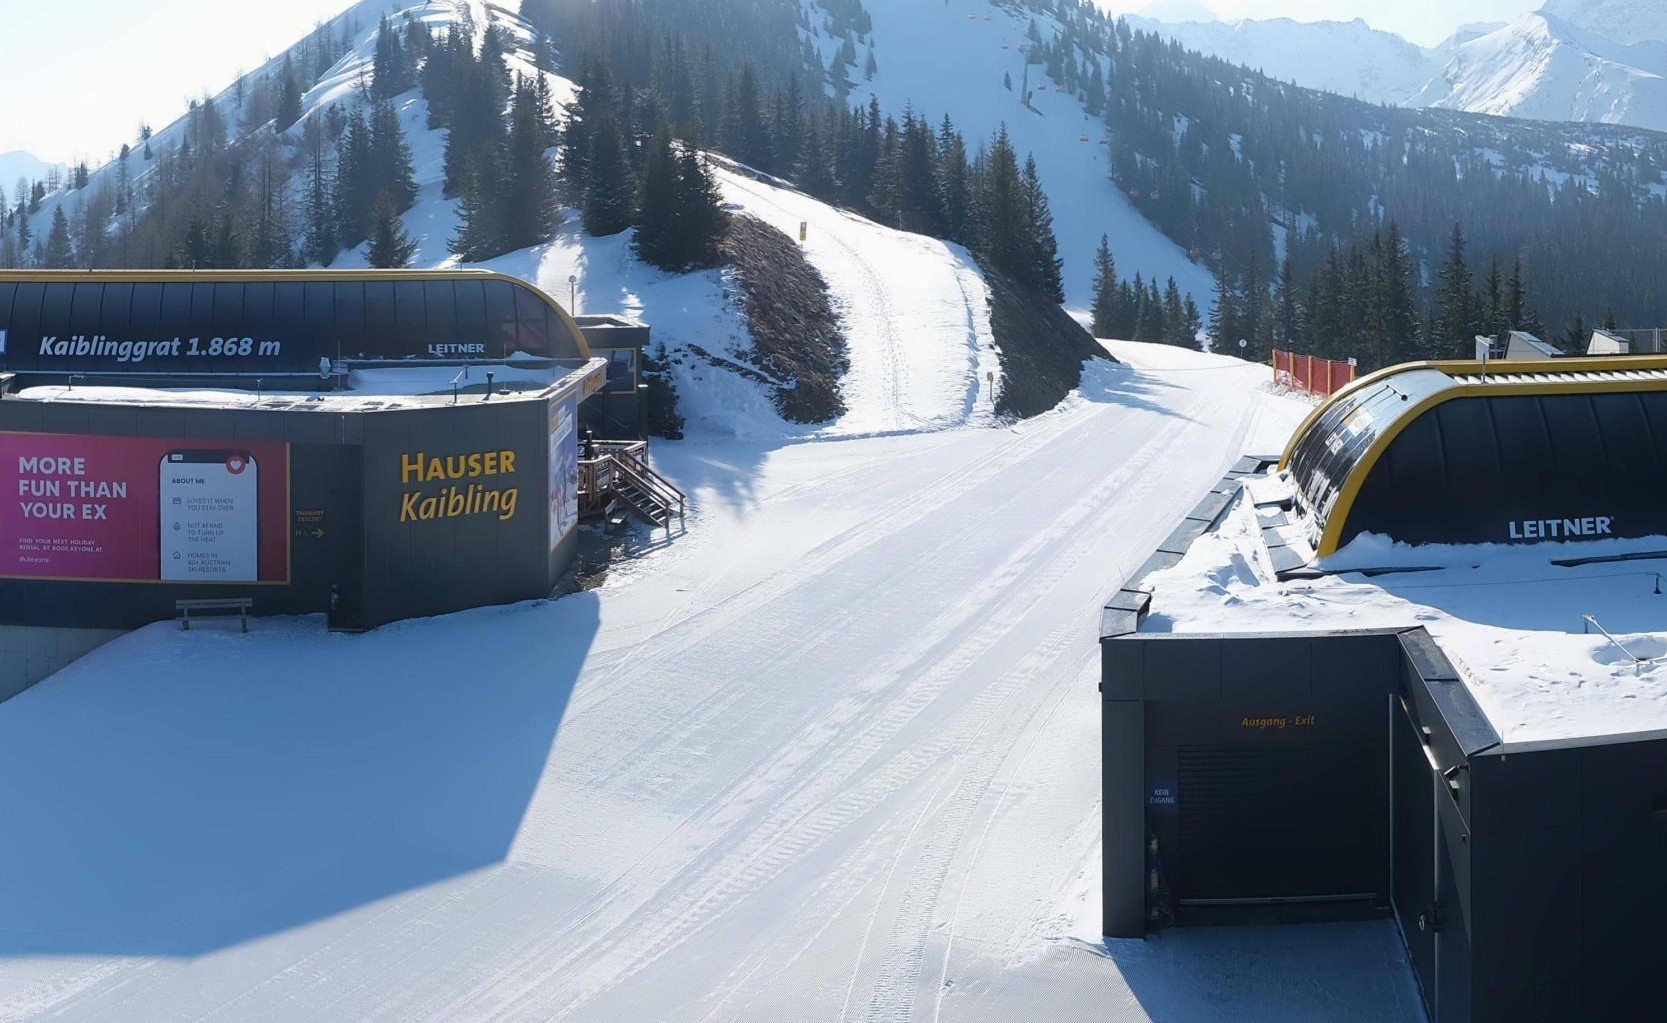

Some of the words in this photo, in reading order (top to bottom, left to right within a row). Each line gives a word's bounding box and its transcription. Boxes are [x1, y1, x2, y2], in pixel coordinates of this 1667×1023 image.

[39, 335, 180, 362] Kaiblinggrat
[186, 337, 253, 356] 1.868
[258, 340, 281, 356] m
[428, 343, 485, 354] LEITNER
[19, 456, 85, 475] MORE
[401, 450, 516, 484] HAUSER
[19, 480, 60, 497] FUN
[67, 481, 127, 498] THAN
[20, 502, 75, 519] YOUR
[82, 504, 107, 520] EX
[400, 484, 518, 522] Kaibling
[1509, 516, 1612, 539] LEITNER
[1241, 717, 1286, 728] Ausgang
[1295, 715, 1316, 725] Exit
